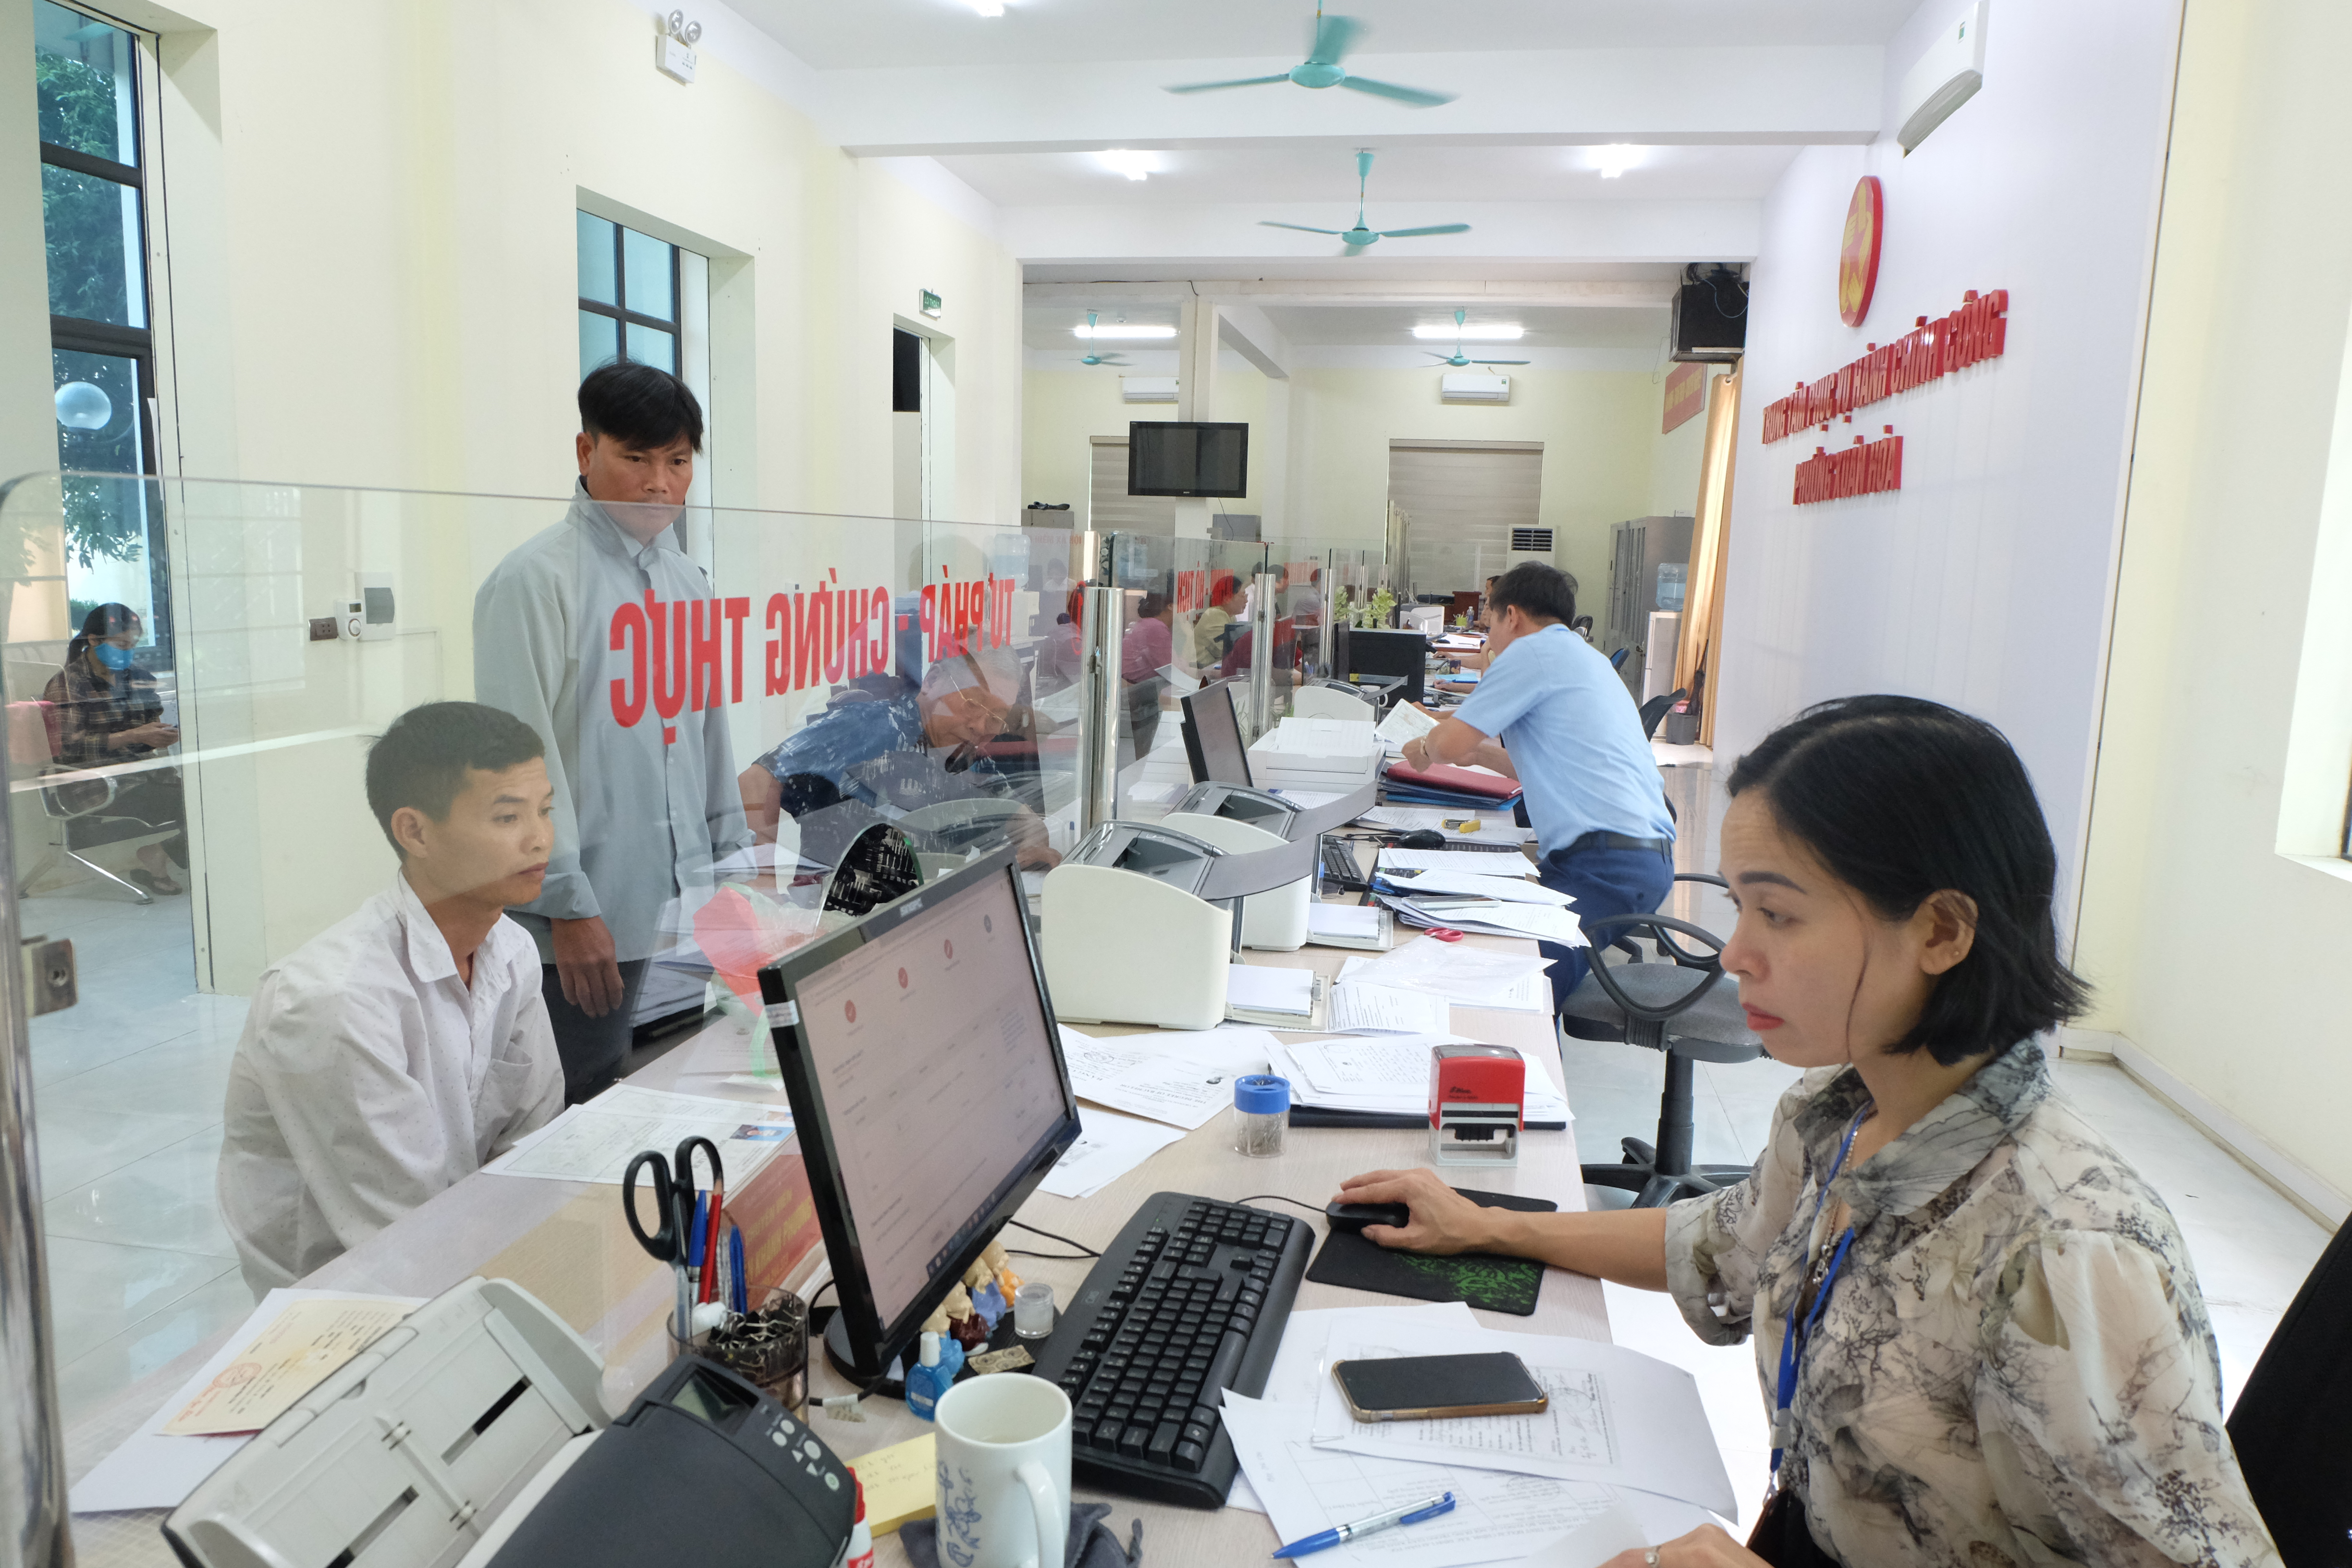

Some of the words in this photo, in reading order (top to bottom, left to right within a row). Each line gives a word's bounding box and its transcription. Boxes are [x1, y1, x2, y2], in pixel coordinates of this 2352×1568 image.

[1762, 397, 1789, 444] TRUNG
[1788, 381, 1810, 433] TÂM
[1808, 372, 1837, 431] PHỤC
[1837, 363, 1854, 423] VỤ
[1852, 343, 1895, 408] HÀNH
[1890, 316, 1948, 393] CHÍNH
[1943, 290, 2009, 373] CÔNG
[1793, 446, 1837, 505] PHƯỜNG
[1832, 435, 1871, 499] XUÂN
